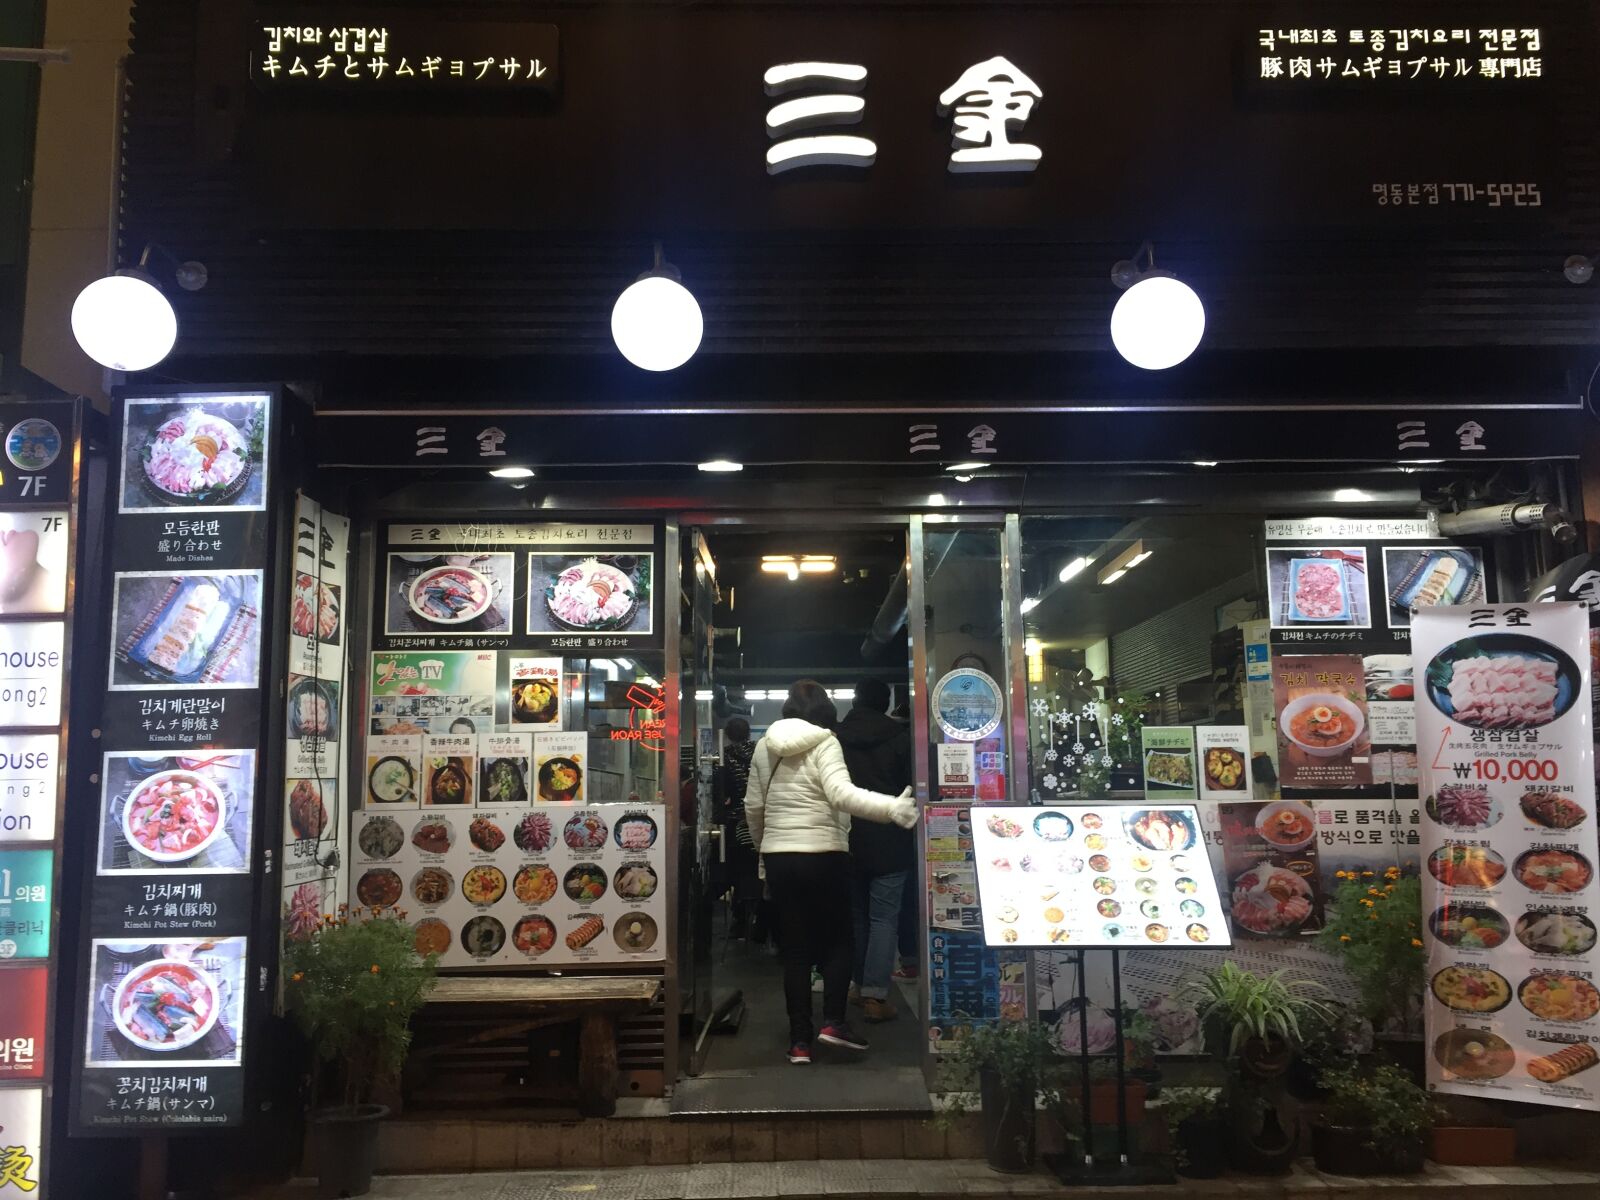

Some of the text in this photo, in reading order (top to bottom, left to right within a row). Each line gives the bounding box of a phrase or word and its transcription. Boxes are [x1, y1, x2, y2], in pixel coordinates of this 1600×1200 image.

[263, 26, 389, 52] 김치와 삼겹살
[1258, 28, 1541, 52] 국내최초 토종김치요리 전문점
[262, 54, 548, 80] キムチとサムギョプサル
[1372, 183, 1542, 206] 명동본점 771-5025
[18, 475, 48, 497] 7F
[41, 517, 63, 533] 7F
[162, 519, 221, 536] 모듬한판
[157, 538, 223, 553] 盛り合わせ
[188, 554, 214, 562] Dishes
[422, 665, 442, 679] TV
[138, 697, 226, 715] 김치계란말이
[141, 716, 220, 731] キムチ卵焼き
[148, 733, 212, 743] Kimchi Egg Roll
[1469, 729, 1540, 742] 생삼겹살
[1519, 751, 1538, 759] Belly
[1524, 784, 1574, 793] 돼지갈비
[1320, 829, 1383, 846] 방식으로
[142, 882, 202, 900] 김치찌개
[124, 902, 218, 917] キムチ鍋(豚肉)
[124, 919, 217, 929] Kimchi Pot Stew (Pork)
[116, 1075, 208, 1094] 꽁치김치찌개
[106, 1095, 215, 1111] キムチ鍋(サンマ)
